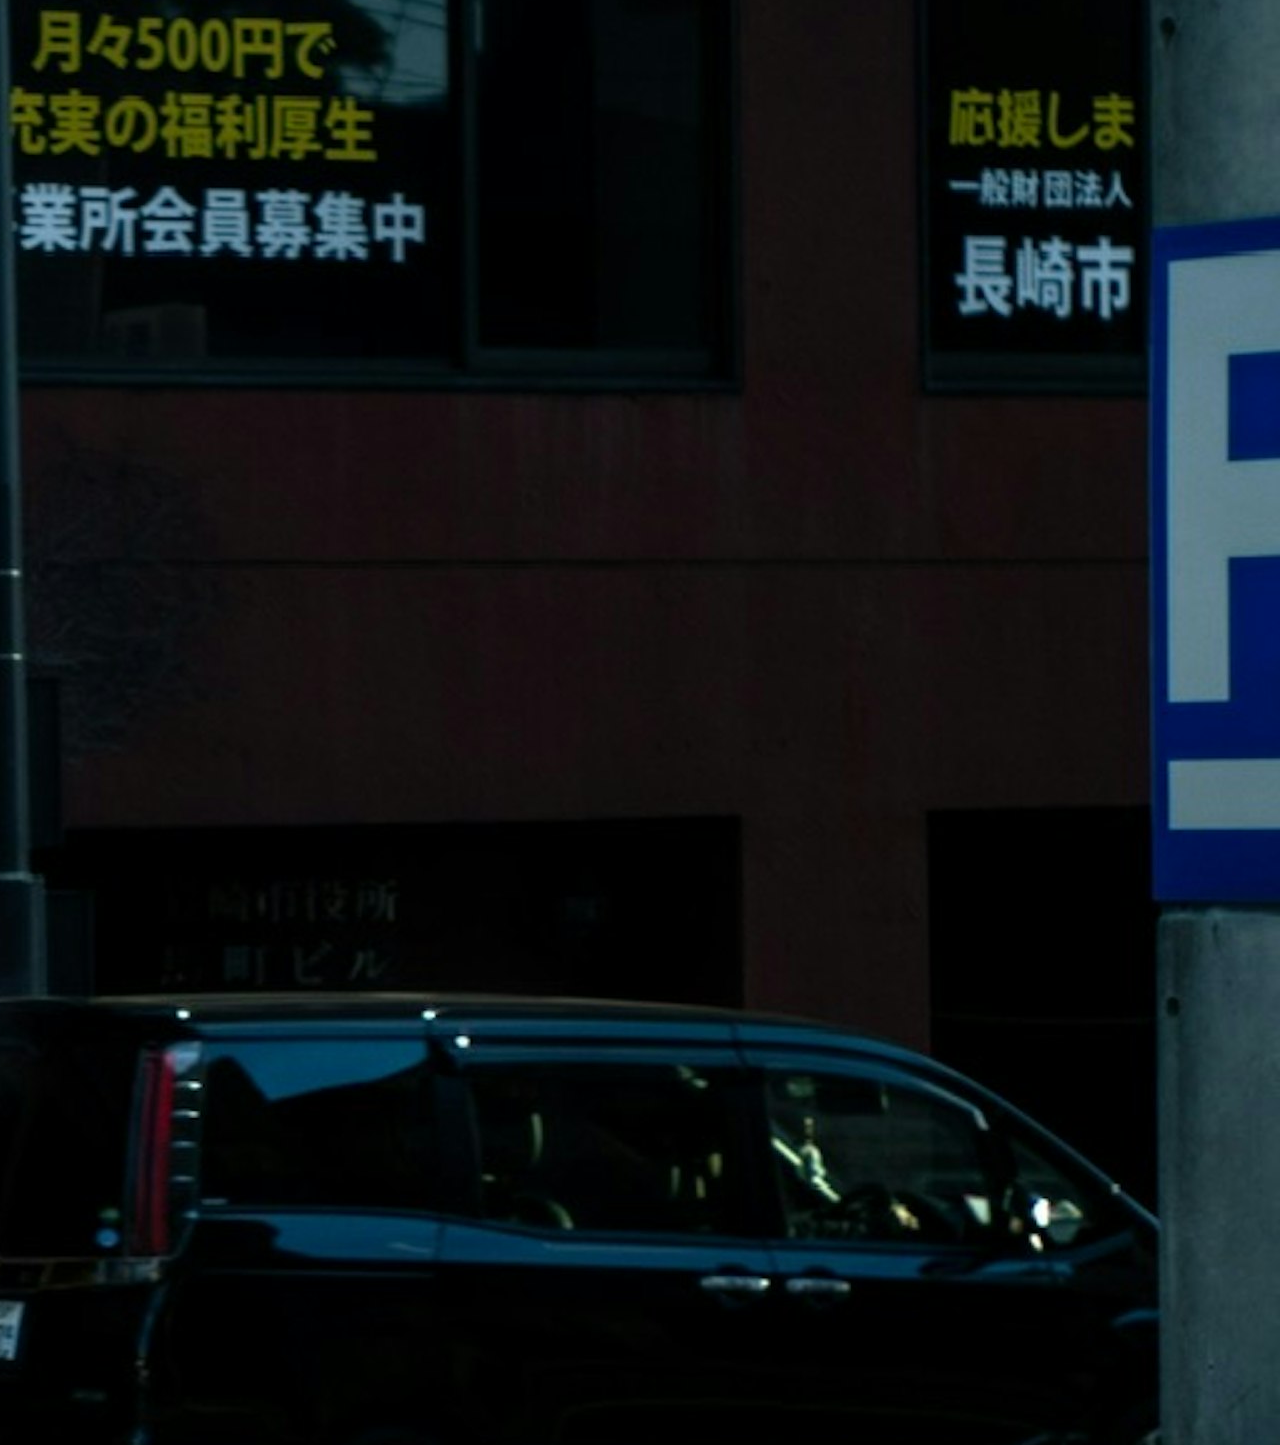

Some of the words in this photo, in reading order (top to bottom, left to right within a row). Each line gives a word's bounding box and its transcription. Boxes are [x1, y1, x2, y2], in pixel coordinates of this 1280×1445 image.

[31, 9, 338, 80] 月々500円で
[948, 87, 1135, 150] 応援しま
[11, 181, 426, 264] 業所会員募集中
[948, 168, 1133, 208] 一般財団法人
[954, 235, 1135, 320] 長崎市
